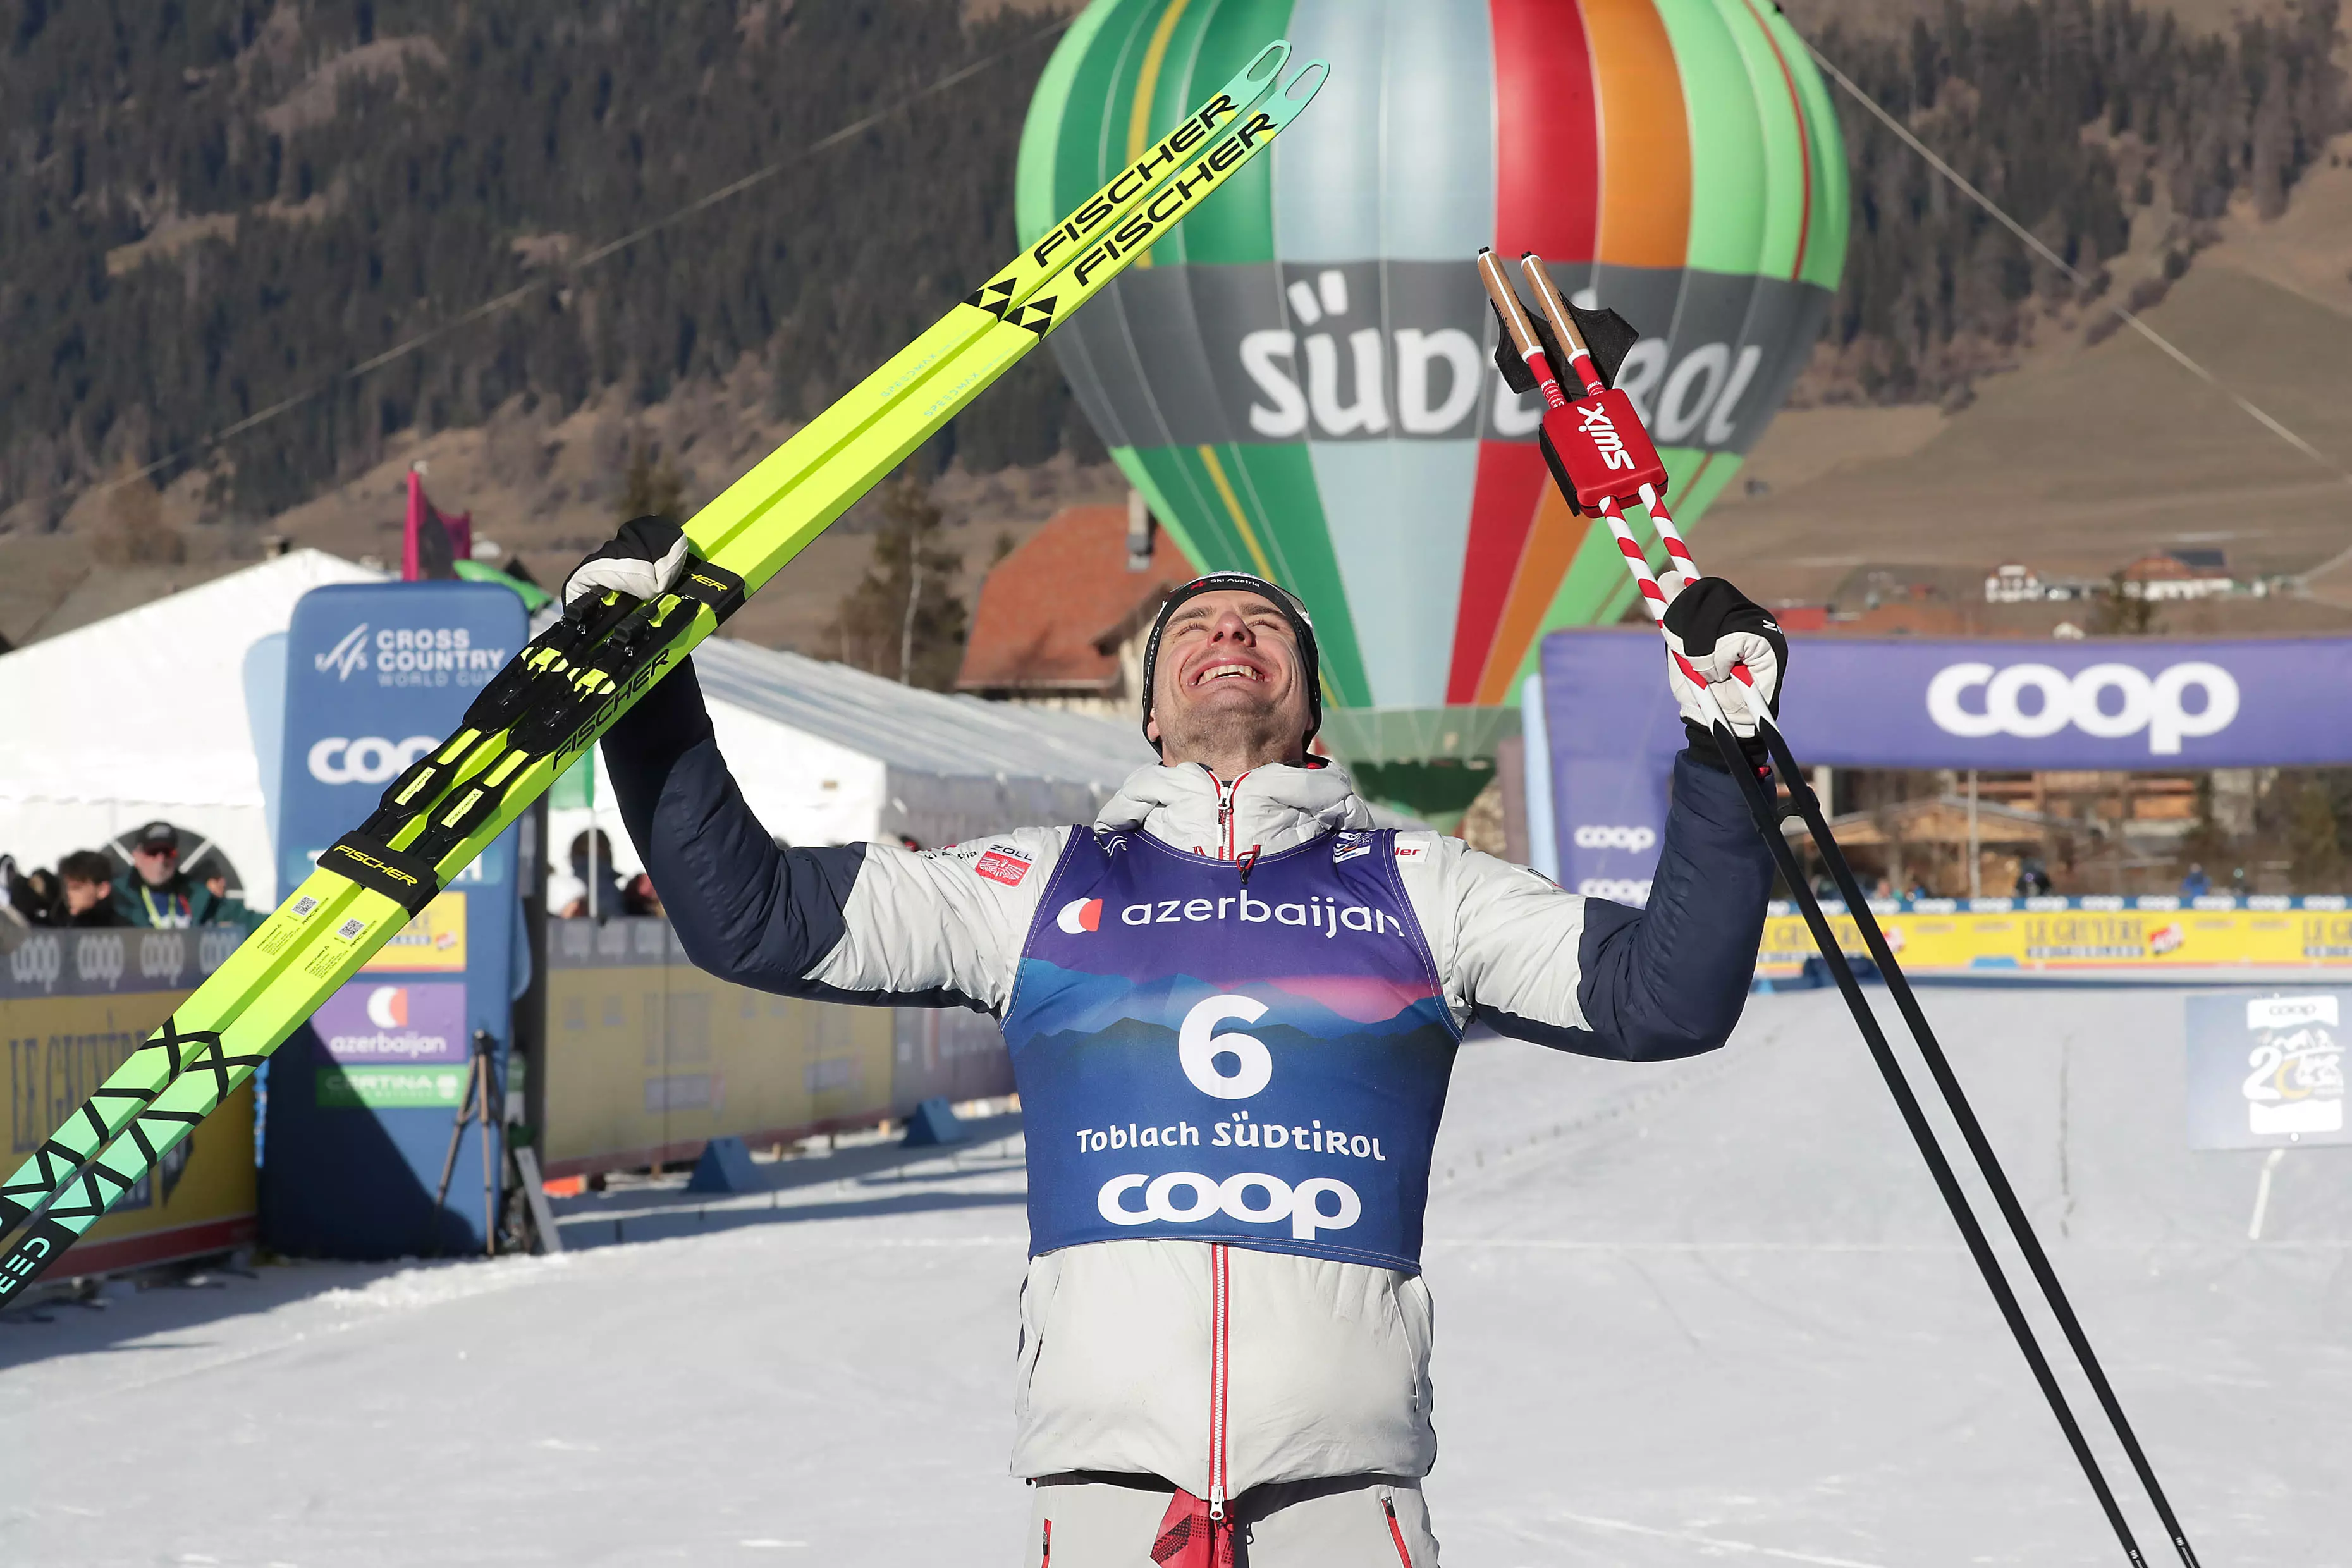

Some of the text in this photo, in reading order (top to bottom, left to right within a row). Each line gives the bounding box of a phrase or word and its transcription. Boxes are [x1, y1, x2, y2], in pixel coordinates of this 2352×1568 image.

[1033, 94, 1239, 268] FISCHER
[1074, 113, 1278, 286] FISCHER
[1577, 401, 1636, 470] swix
[1227, 578, 1260, 587] Austria
[376, 628, 470, 650] CROSS
[376, 649, 505, 672] COUNTRY
[377, 671, 450, 687] WORLD
[552, 648, 670, 771] FISCHER
[1926, 662, 2240, 755] coop
[989, 843, 1033, 862] ZOLL
[1574, 824, 1656, 854] coop
[333, 844, 418, 887] FISCHER
[1120, 888, 1406, 940] azerbaijan
[329, 1031, 447, 1058] azerbaijan
[1178, 994, 1273, 1100] 6
[1075, 1121, 1200, 1154] Toblach
[1097, 1172, 1362, 1241] coop
